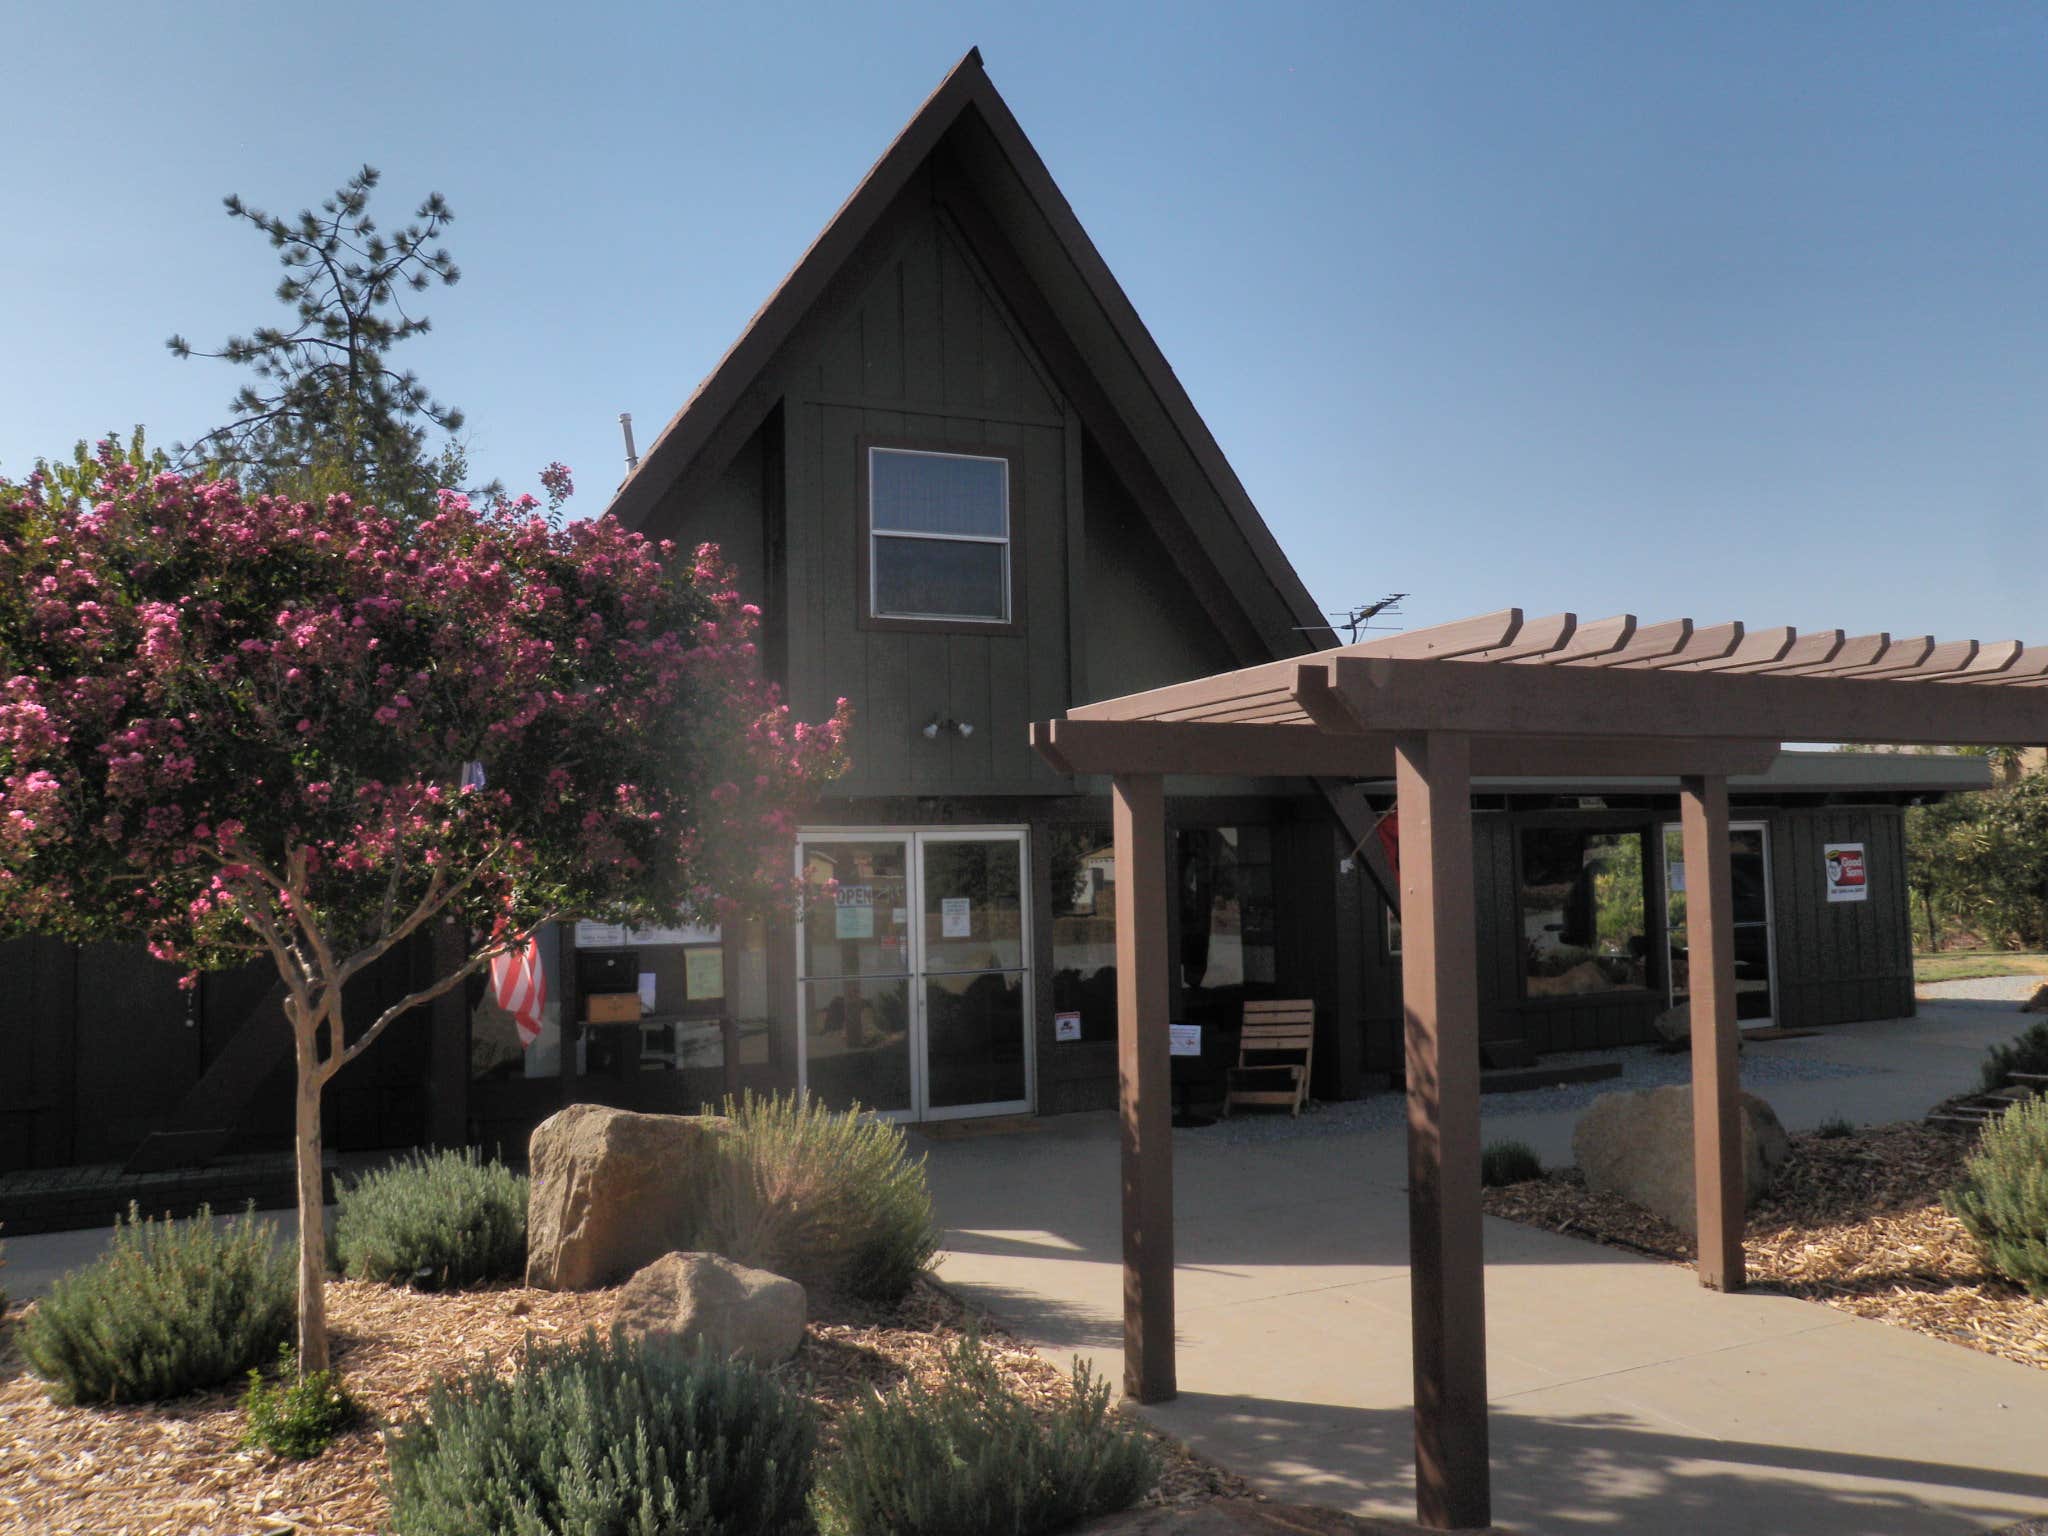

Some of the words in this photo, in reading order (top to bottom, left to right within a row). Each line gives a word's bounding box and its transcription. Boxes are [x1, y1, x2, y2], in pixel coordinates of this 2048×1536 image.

[1841, 857, 1862, 866] Good
[1846, 867, 1863, 876] Sam
[838, 887, 871, 904] OPEN
